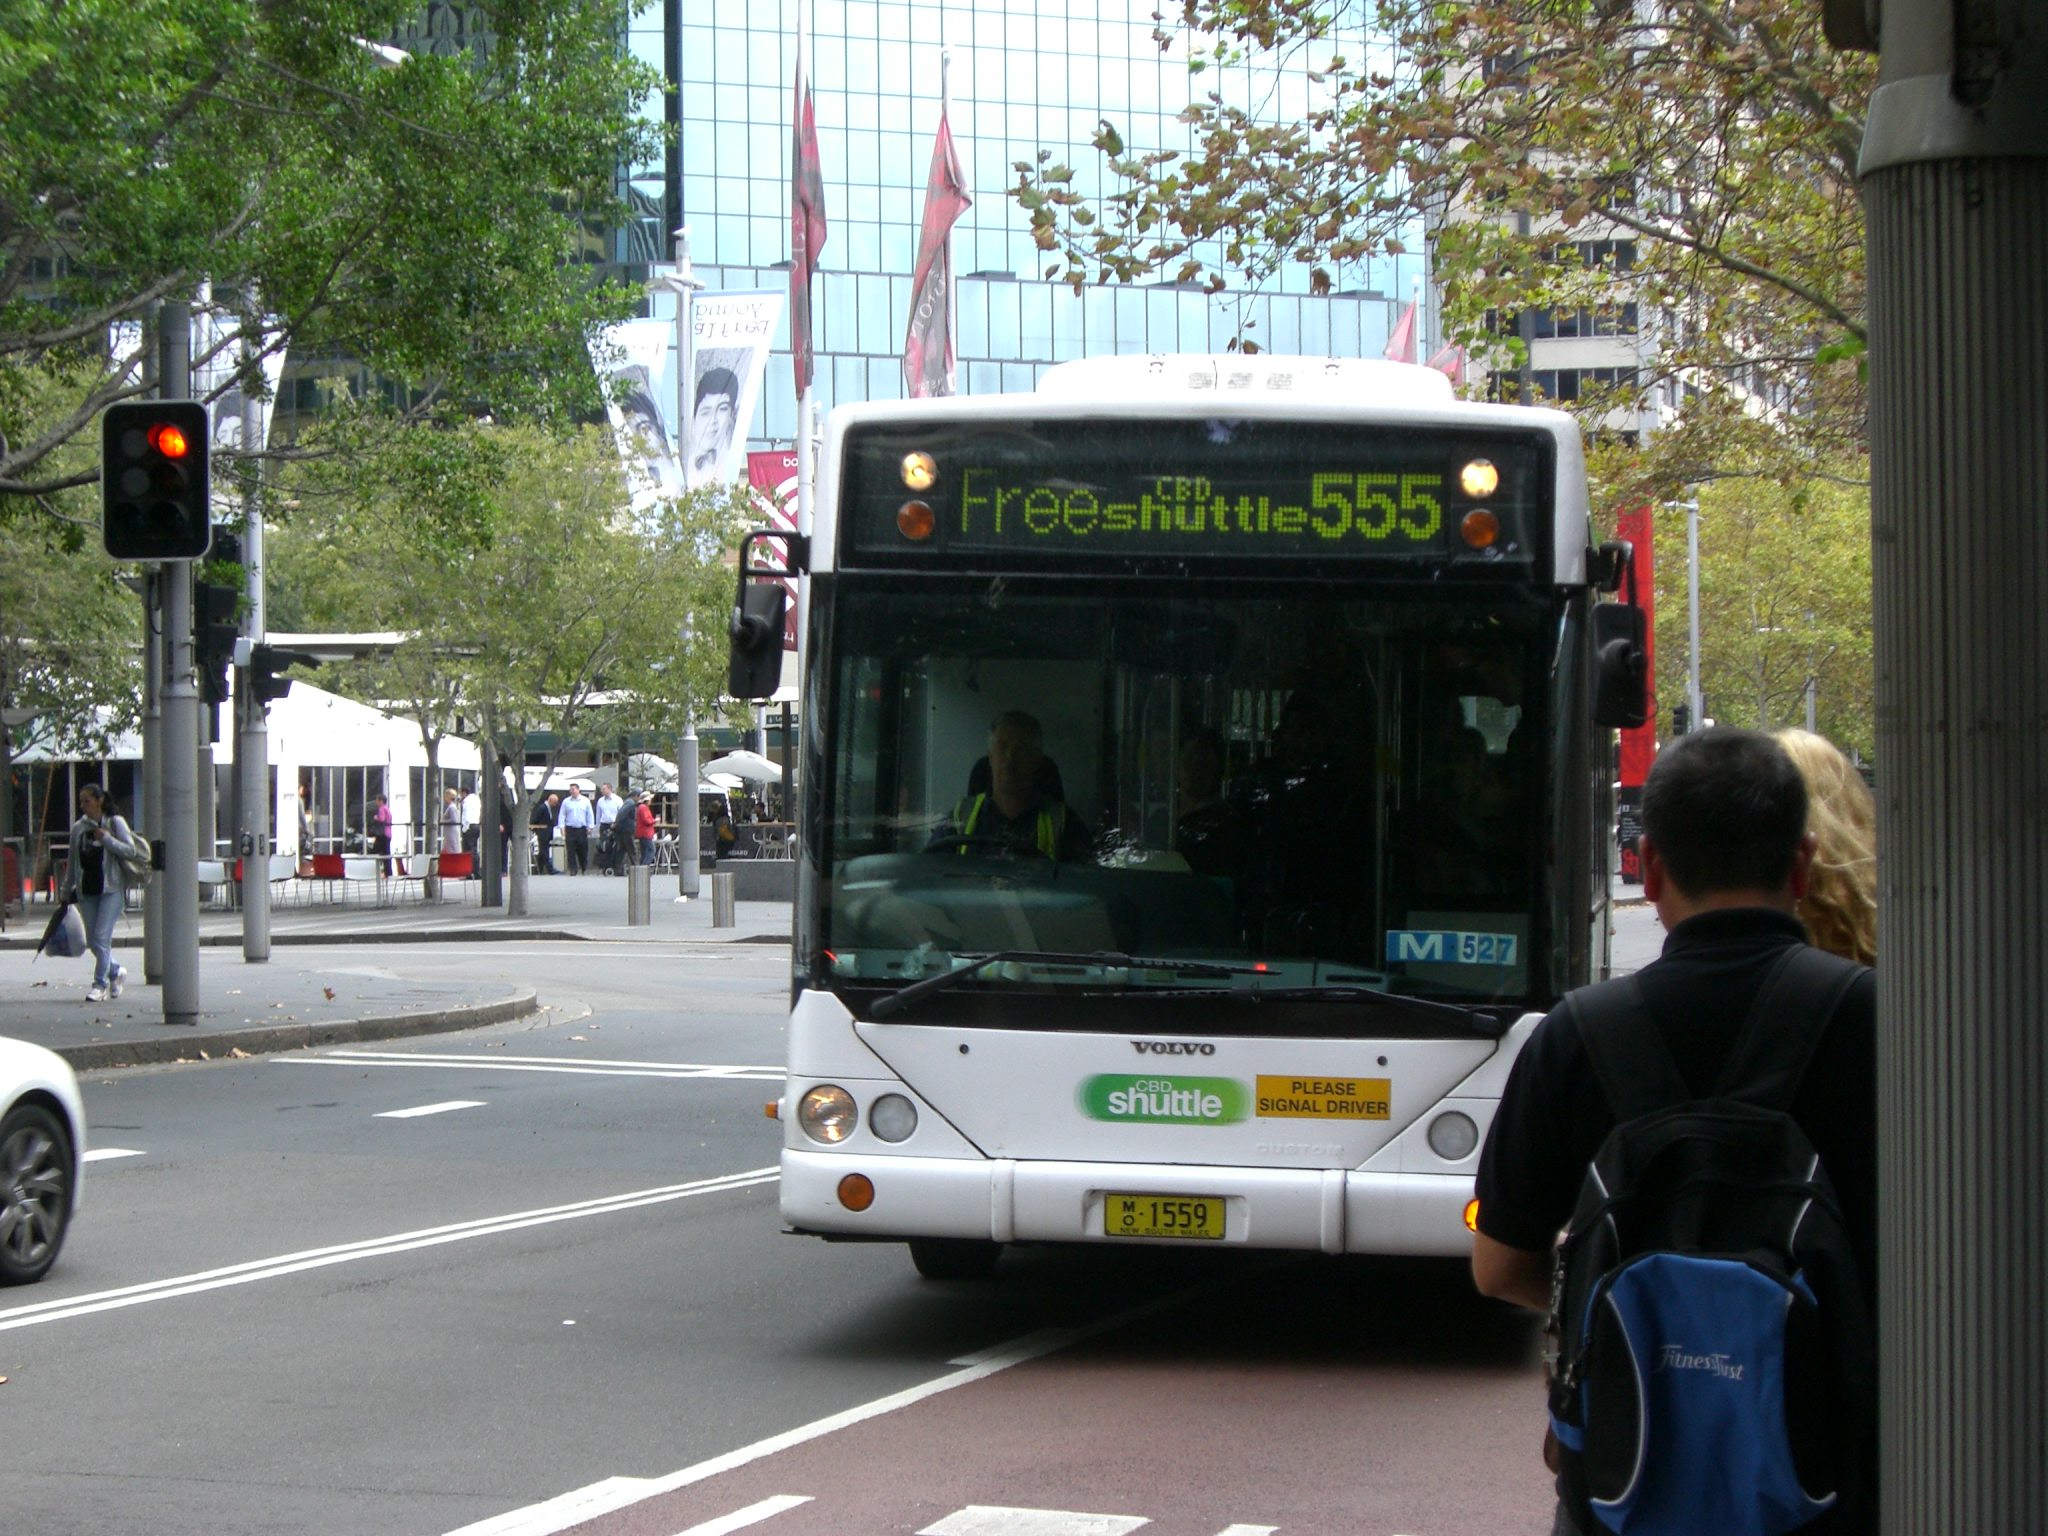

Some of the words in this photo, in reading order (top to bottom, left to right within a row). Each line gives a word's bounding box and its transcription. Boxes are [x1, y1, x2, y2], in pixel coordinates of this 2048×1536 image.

[1156, 476, 1211, 500] CBD
[962, 468, 1098, 534] Free
[1102, 494, 1308, 532] shuttle
[1312, 473, 1441, 539] 555
[1400, 933, 1443, 960] M
[1462, 935, 1513, 962] 527
[1130, 1041, 1216, 1056] VOLVO
[1136, 1080, 1172, 1093] CBD
[1292, 1081, 1356, 1096] PLEASE
[1108, 1087, 1223, 1118] shuttle
[1259, 1098, 1321, 1113] SIGNAL
[1326, 1099, 1389, 1115] DRIVER
